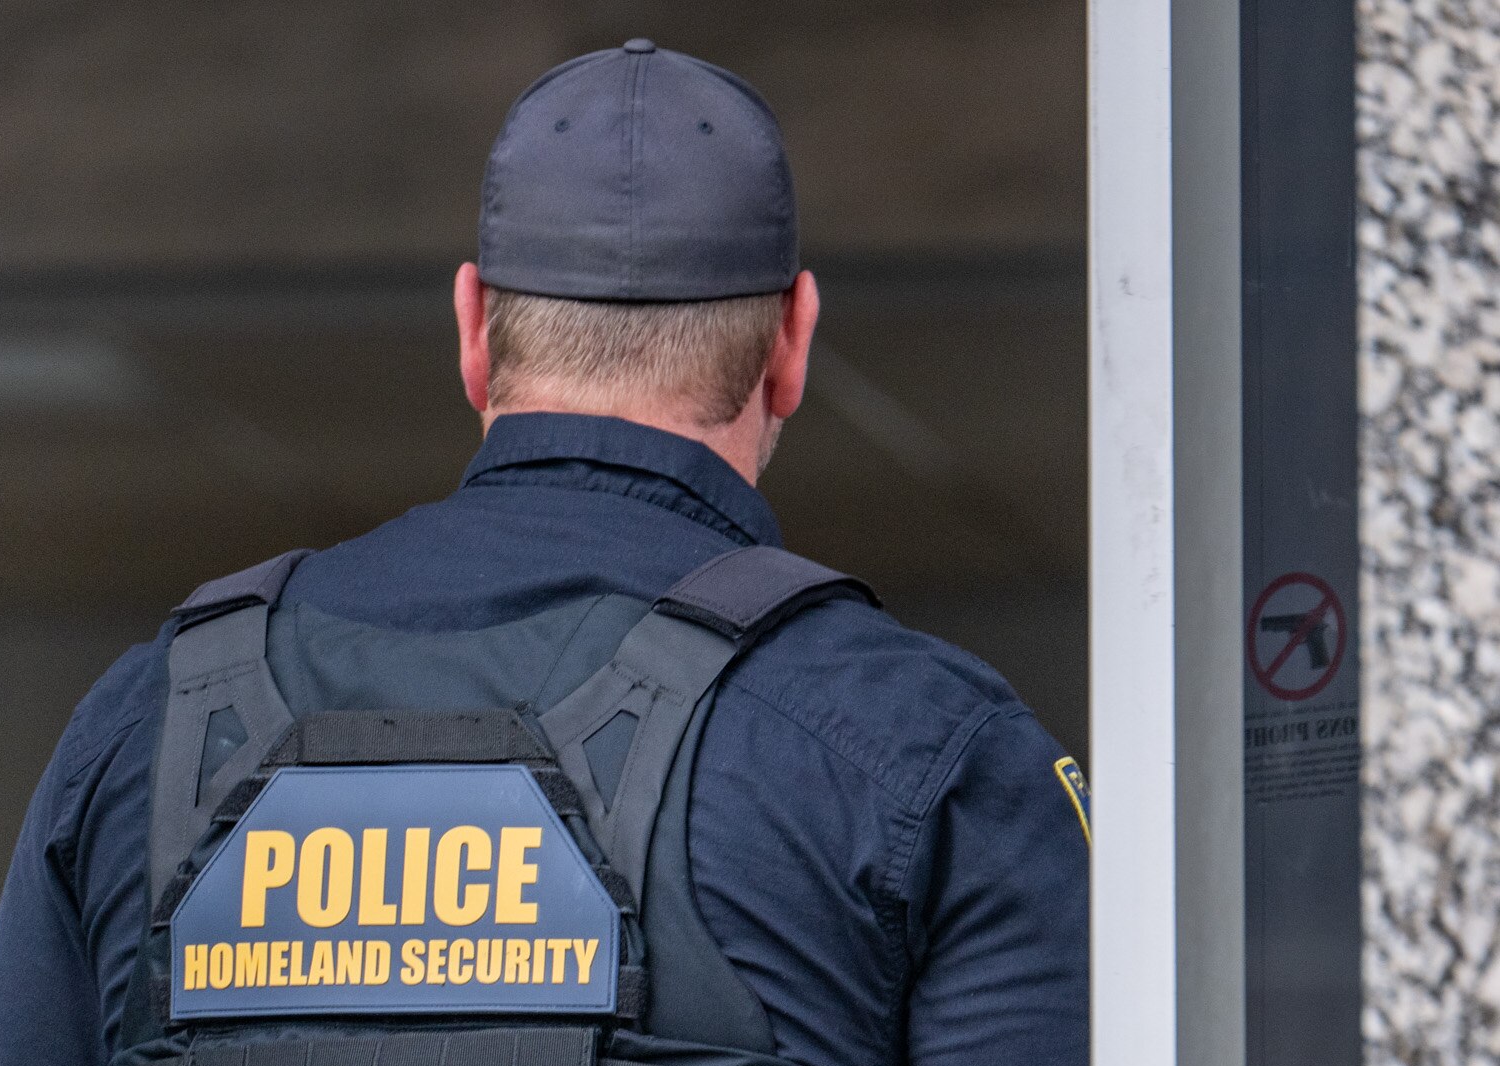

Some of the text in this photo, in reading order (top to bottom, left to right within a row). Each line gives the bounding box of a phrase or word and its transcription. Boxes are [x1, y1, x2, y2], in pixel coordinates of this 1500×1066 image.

[240, 825, 543, 928] POLICE
[183, 937, 599, 990] HOMELAND SECURITY
